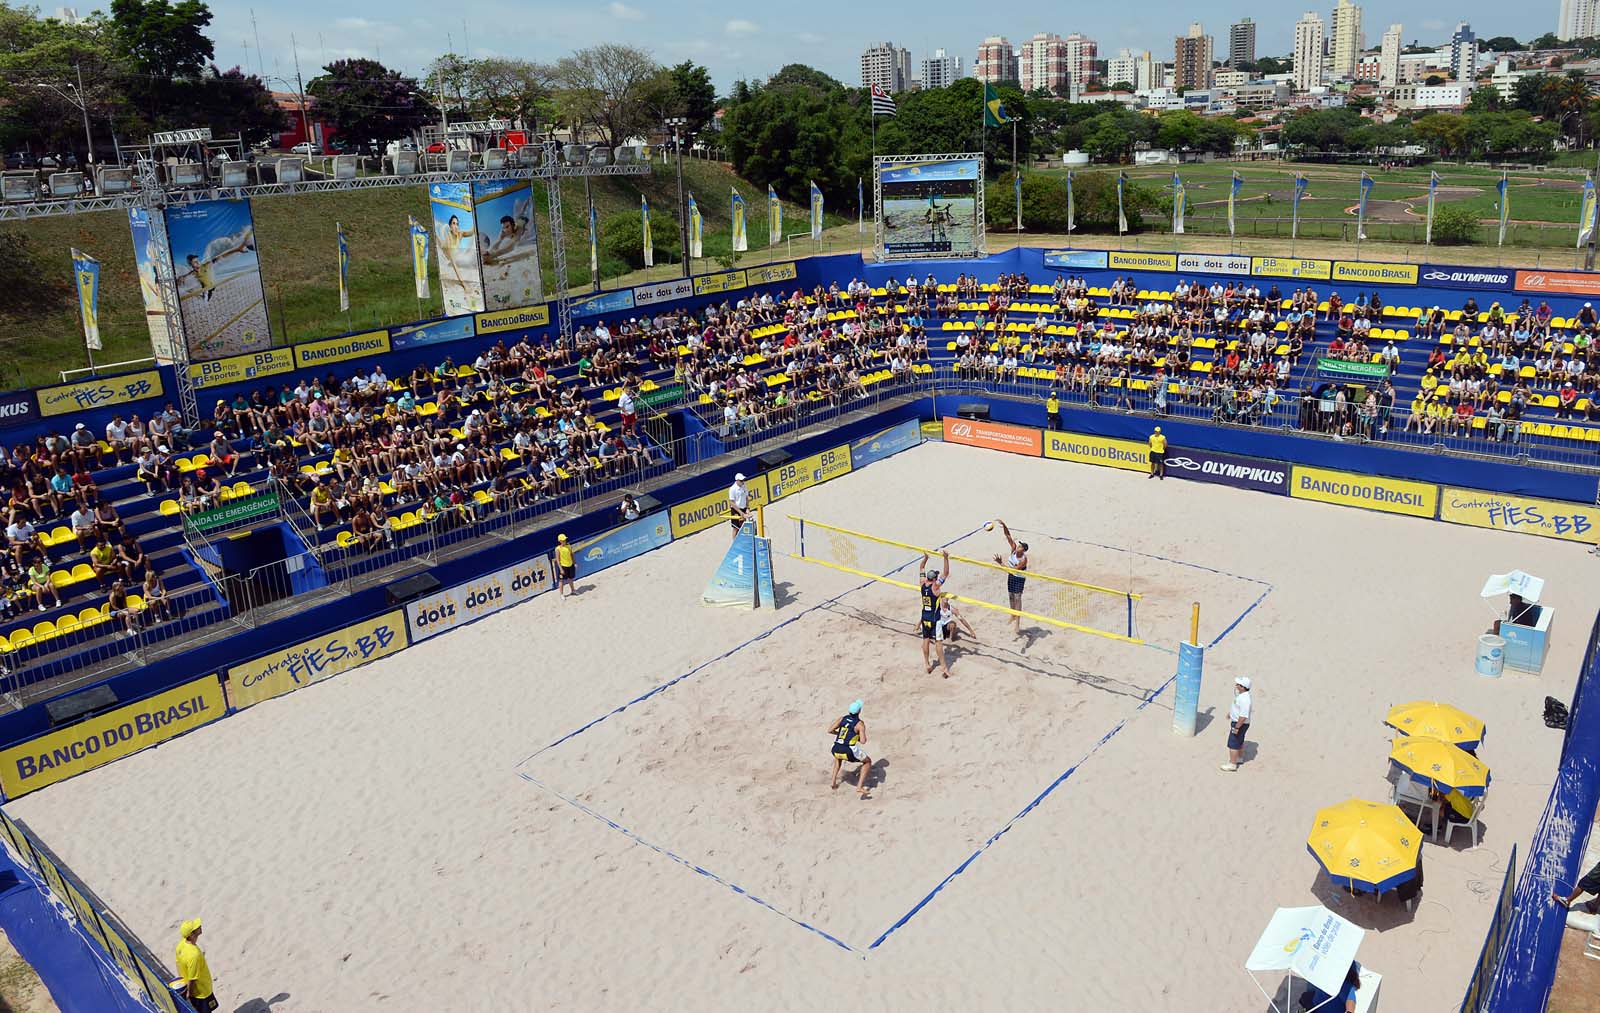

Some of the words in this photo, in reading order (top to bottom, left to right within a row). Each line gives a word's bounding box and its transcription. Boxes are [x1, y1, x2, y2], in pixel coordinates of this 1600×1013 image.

[1113, 256, 1137, 265] BANCO
[1137, 258, 1147, 266] DO
[1147, 256, 1172, 267] BRASIL
[1180, 258, 1199, 268] dotz
[1204, 259, 1222, 268] dotz
[1228, 260, 1247, 270] dotz
[1338, 266, 1368, 277] BANCO
[1368, 268, 1380, 278] DO
[1381, 268, 1412, 279] BRASIL
[1450, 272, 1508, 284] OLYMPIKUS
[481, 316, 508, 328] BANCO
[508, 316, 519, 324] DO
[520, 311, 545, 323] BRASIL
[302, 347, 337, 361] BANCO
[338, 346, 350, 355] DO
[351, 338, 384, 353] BRASIL
[254, 352, 273, 365] BB
[256, 360, 290, 372] Esportes
[202, 362, 221, 375] BB
[203, 370, 240, 382] Esportes
[74, 385, 115, 407] FIES
[125, 380, 151, 398] BB
[950, 423, 974, 438] GOL
[821, 451, 835, 466] BB
[1051, 438, 1090, 456] BANCO
[1092, 446, 1107, 458] DO
[1108, 447, 1148, 464] BRASIL
[780, 465, 796, 481] BB
[822, 460, 848, 475] Esportes
[1202, 460, 1285, 485] OLYMPIKUS
[781, 474, 810, 490] Esportes
[1300, 475, 1349, 496] BANCO
[1352, 484, 1371, 497] DO
[1374, 486, 1424, 507] BRASIL
[213, 512, 224, 520] DE
[226, 498, 276, 517] EMERGÊNCIA
[1451, 498, 1502, 508] Contrate
[678, 504, 714, 528] BANCO
[715, 499, 728, 514] DO
[1488, 507, 1544, 526] FIES
[1552, 514, 1592, 535] BB
[733, 555, 743, 576] 1
[511, 568, 545, 592] dotz
[465, 584, 503, 609] dotz
[416, 602, 456, 627] dotz
[286, 640, 348, 684] FIES
[356, 624, 395, 661] BB
[242, 652, 302, 688] Contrate
[16, 735, 100, 780] BANCO
[102, 722, 133, 748] DO
[134, 695, 210, 736] BRASIL
